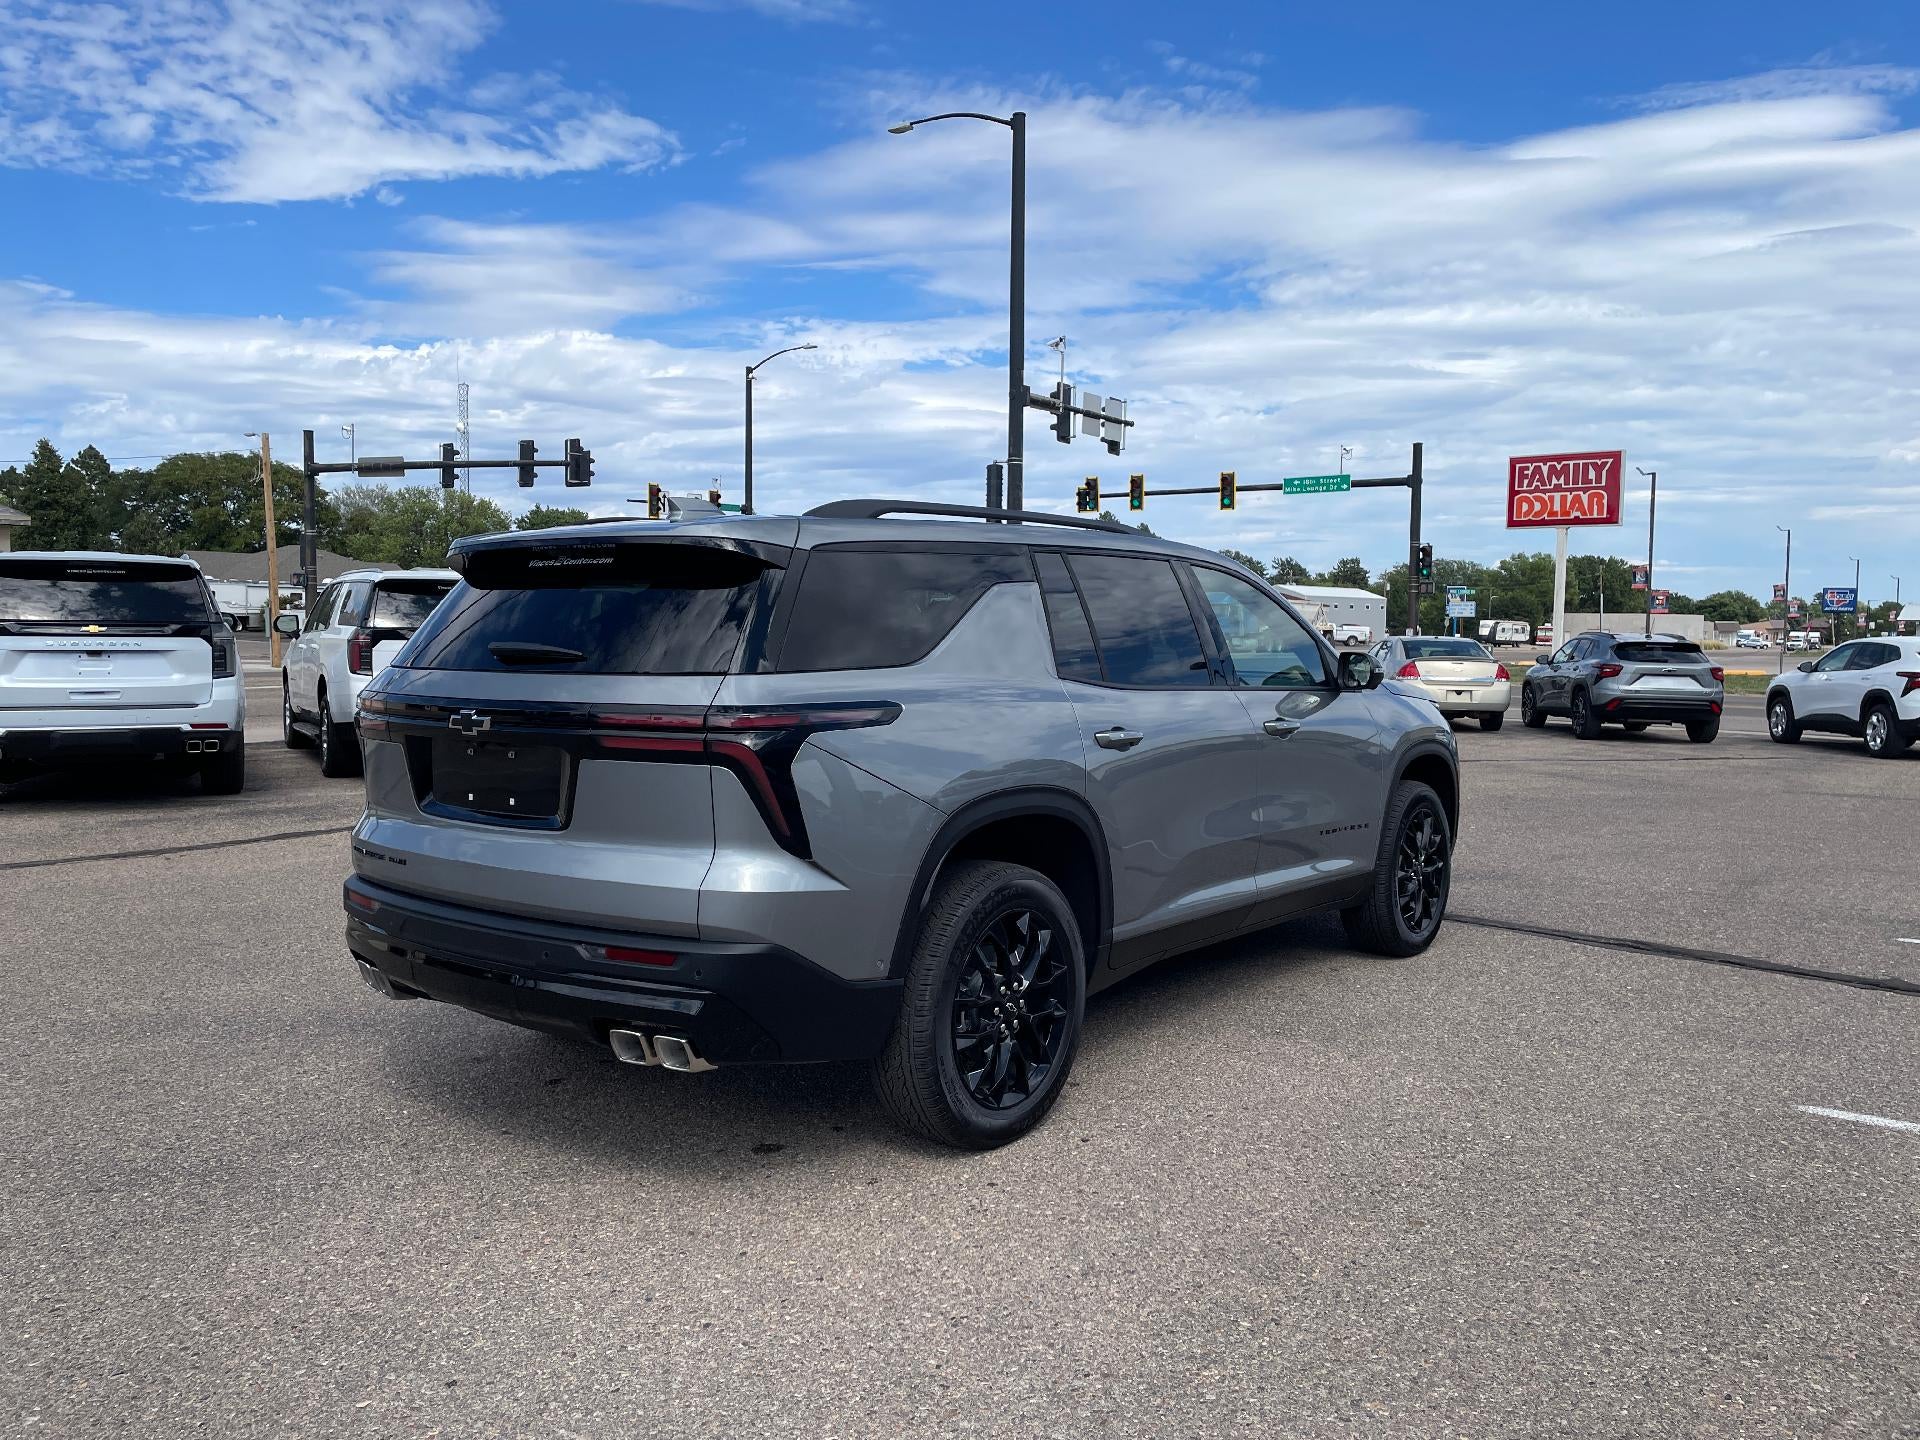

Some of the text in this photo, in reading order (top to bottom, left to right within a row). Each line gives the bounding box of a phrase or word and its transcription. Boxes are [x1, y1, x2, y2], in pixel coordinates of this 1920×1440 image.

[1515, 459, 1613, 490] FAMILY
[1513, 490, 1607, 520] DOLLAR
[1320, 823, 1368, 836] TRAVERSE
